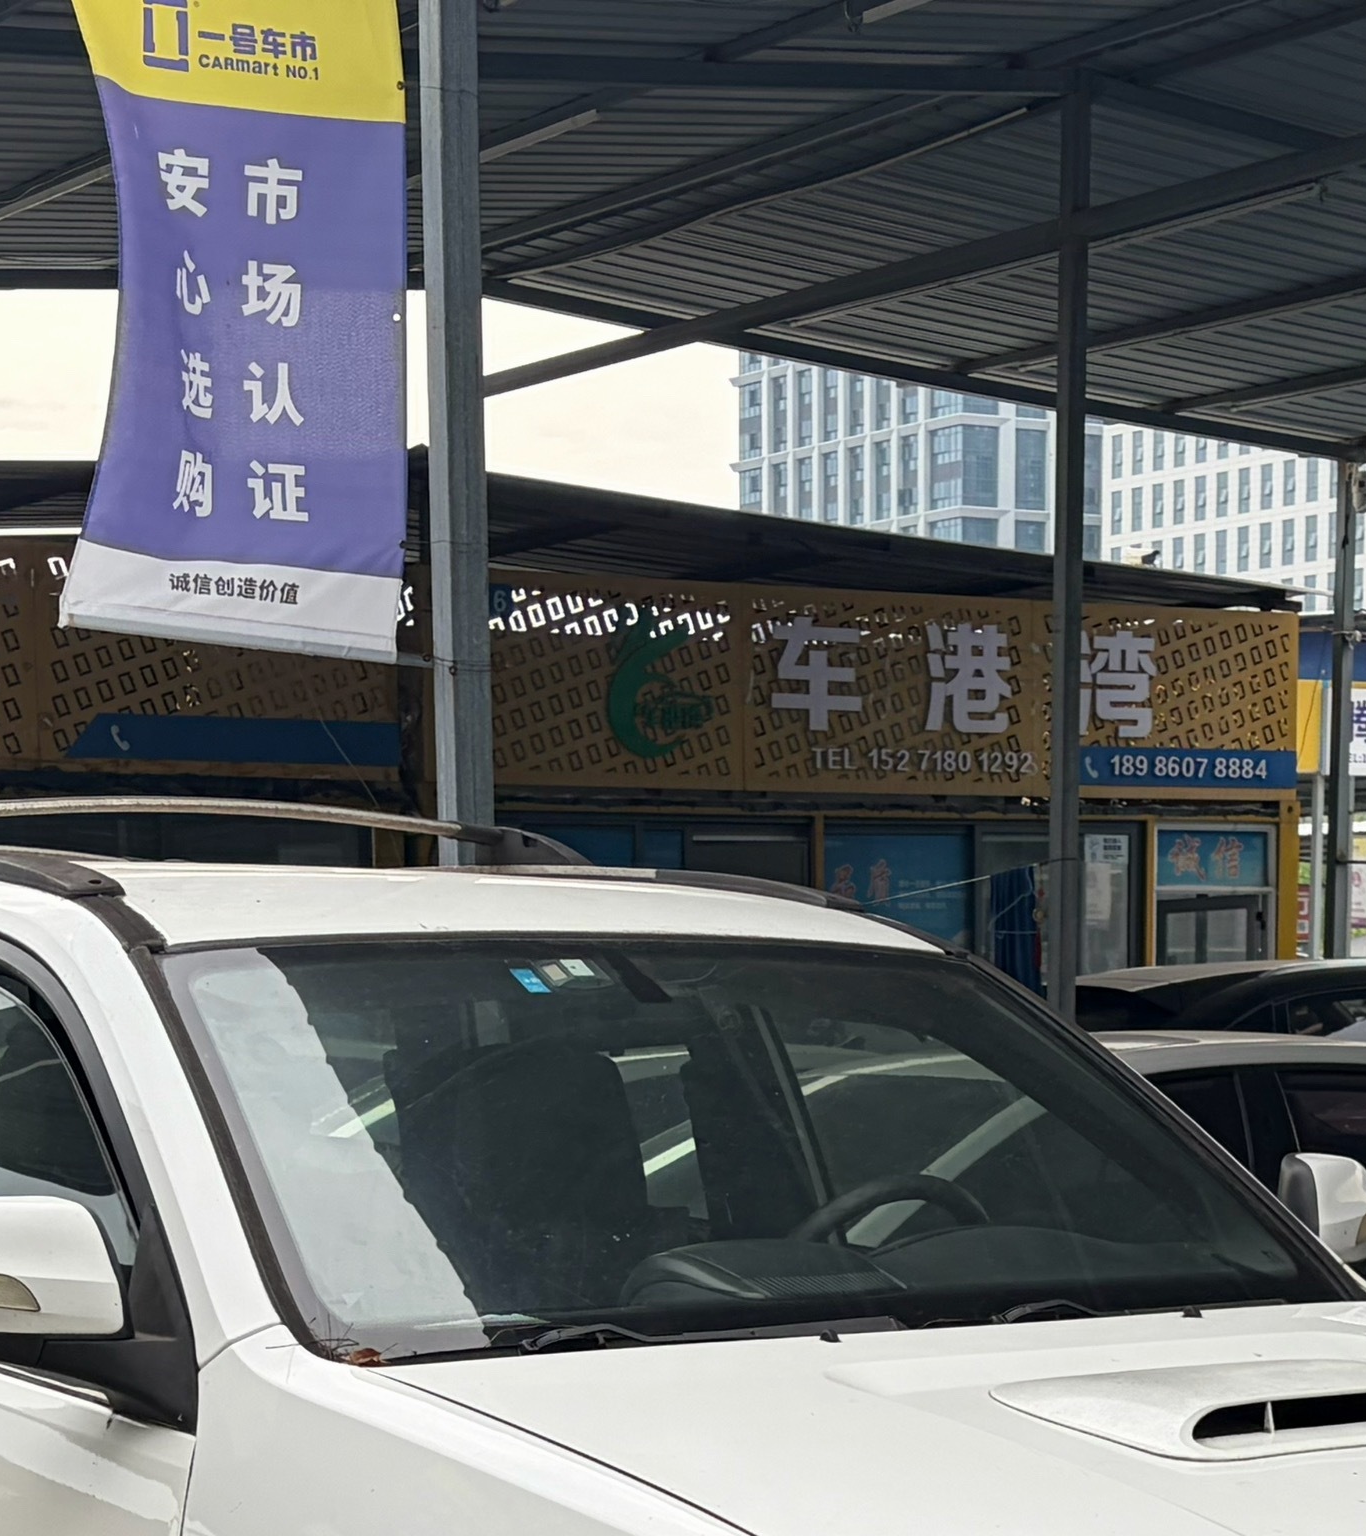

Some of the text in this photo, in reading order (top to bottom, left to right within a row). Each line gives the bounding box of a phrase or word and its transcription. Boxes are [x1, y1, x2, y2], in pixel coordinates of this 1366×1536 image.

[198, 23, 318, 61] 一号车市
[198, 54, 319, 80] CARmart NO.1
[157, 148, 213, 518] 安心选购
[242, 158, 309, 522] 市场认证
[169, 573, 300, 605] 诚信创造价值
[771, 616, 1157, 738] 车港湾
[812, 748, 1034, 774] TEL 152 7180 1292
[1110, 755, 1267, 779] 189 8607 8884
